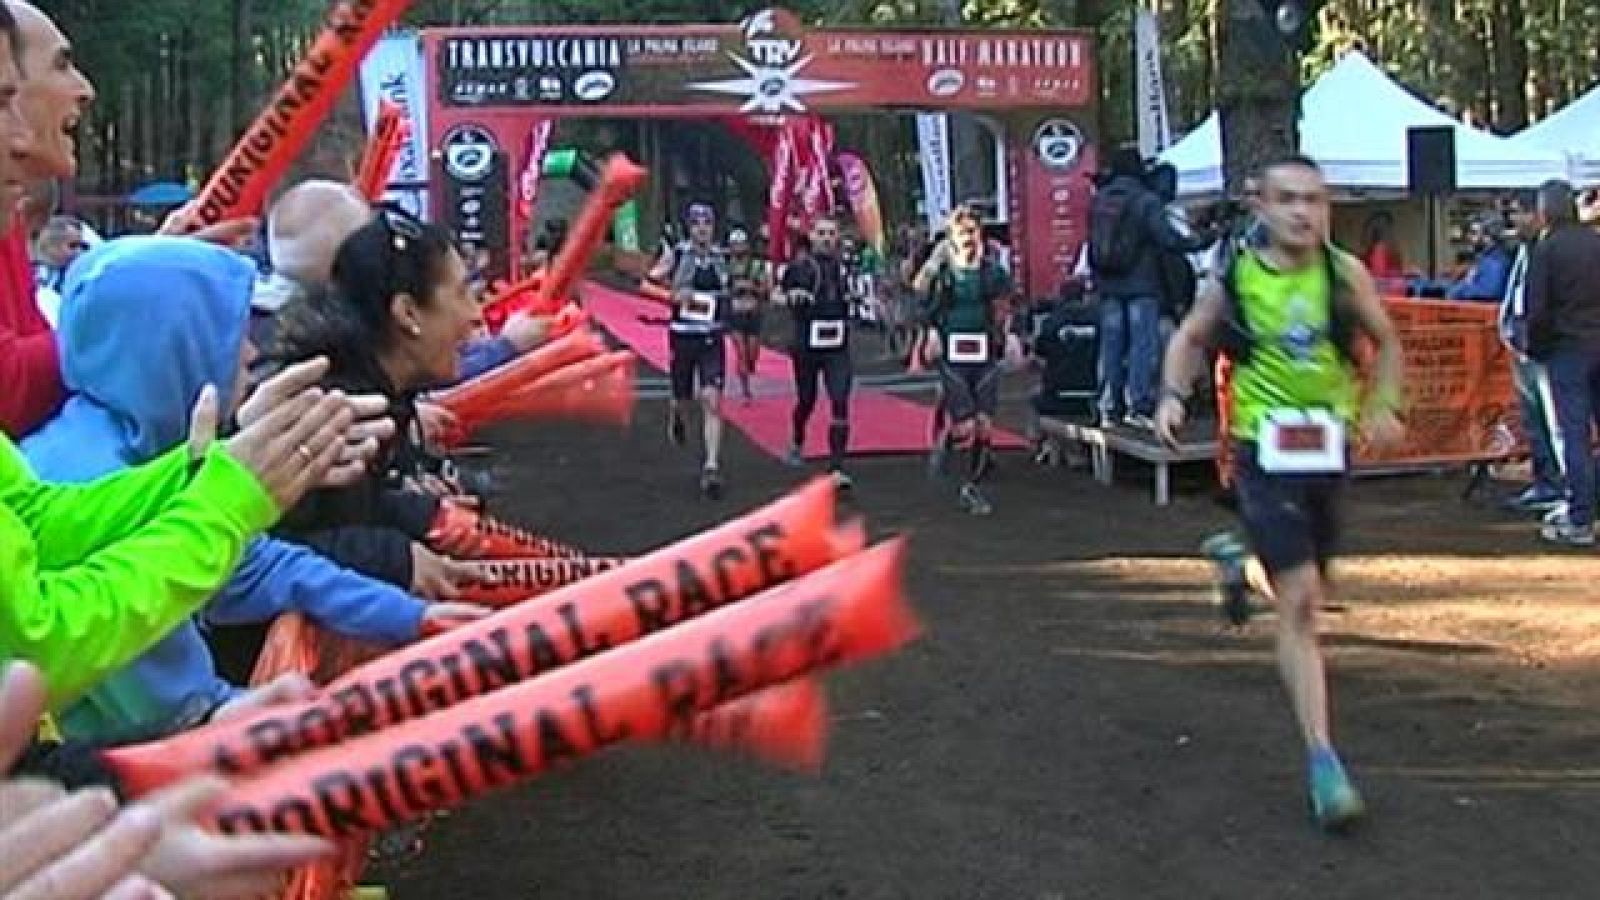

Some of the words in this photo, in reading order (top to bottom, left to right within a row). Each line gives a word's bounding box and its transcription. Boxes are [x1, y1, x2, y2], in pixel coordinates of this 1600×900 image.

[448, 39, 621, 67] TRANSVULCANIA
[922, 39, 968, 67] HALF
[978, 39, 1081, 68] MARATHON
[624, 521, 796, 632] RACE
